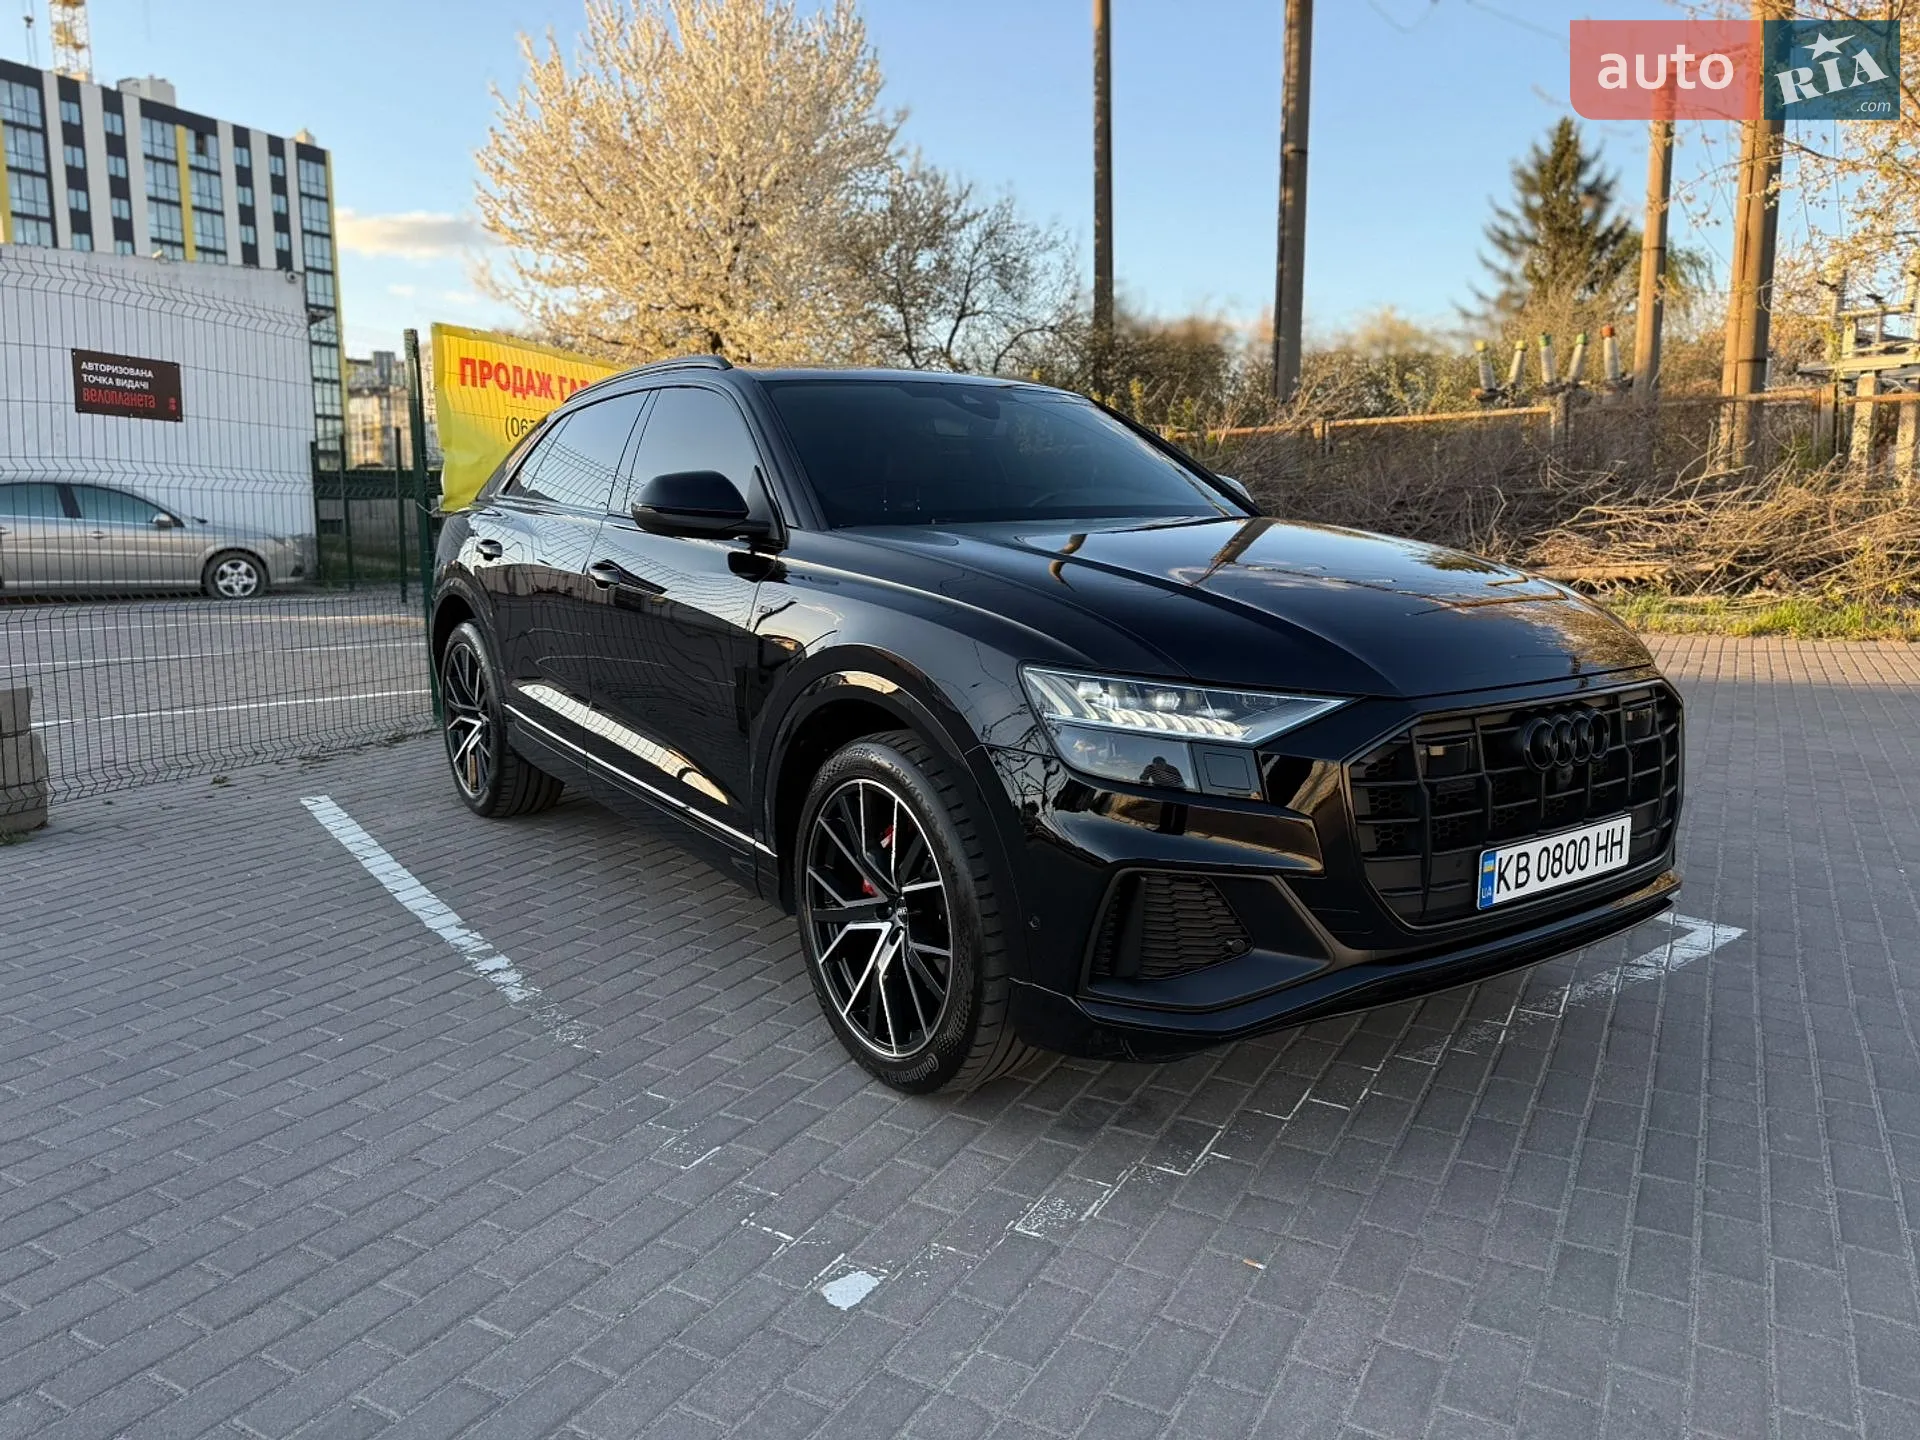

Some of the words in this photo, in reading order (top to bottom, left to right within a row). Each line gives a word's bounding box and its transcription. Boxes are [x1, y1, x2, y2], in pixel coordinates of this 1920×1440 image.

[81, 361, 154, 378] АВТОРИЗОВАНА
[81, 373, 114, 385] ТОЧКА
[115, 378, 150, 390] ВИДАЧІ
[460, 357, 555, 400] ПРОДАЖ
[1496, 851, 1531, 894] KB
[1536, 836, 1590, 882] 0800
[1595, 825, 1625, 867] HH
[1481, 886, 1492, 898] UA
